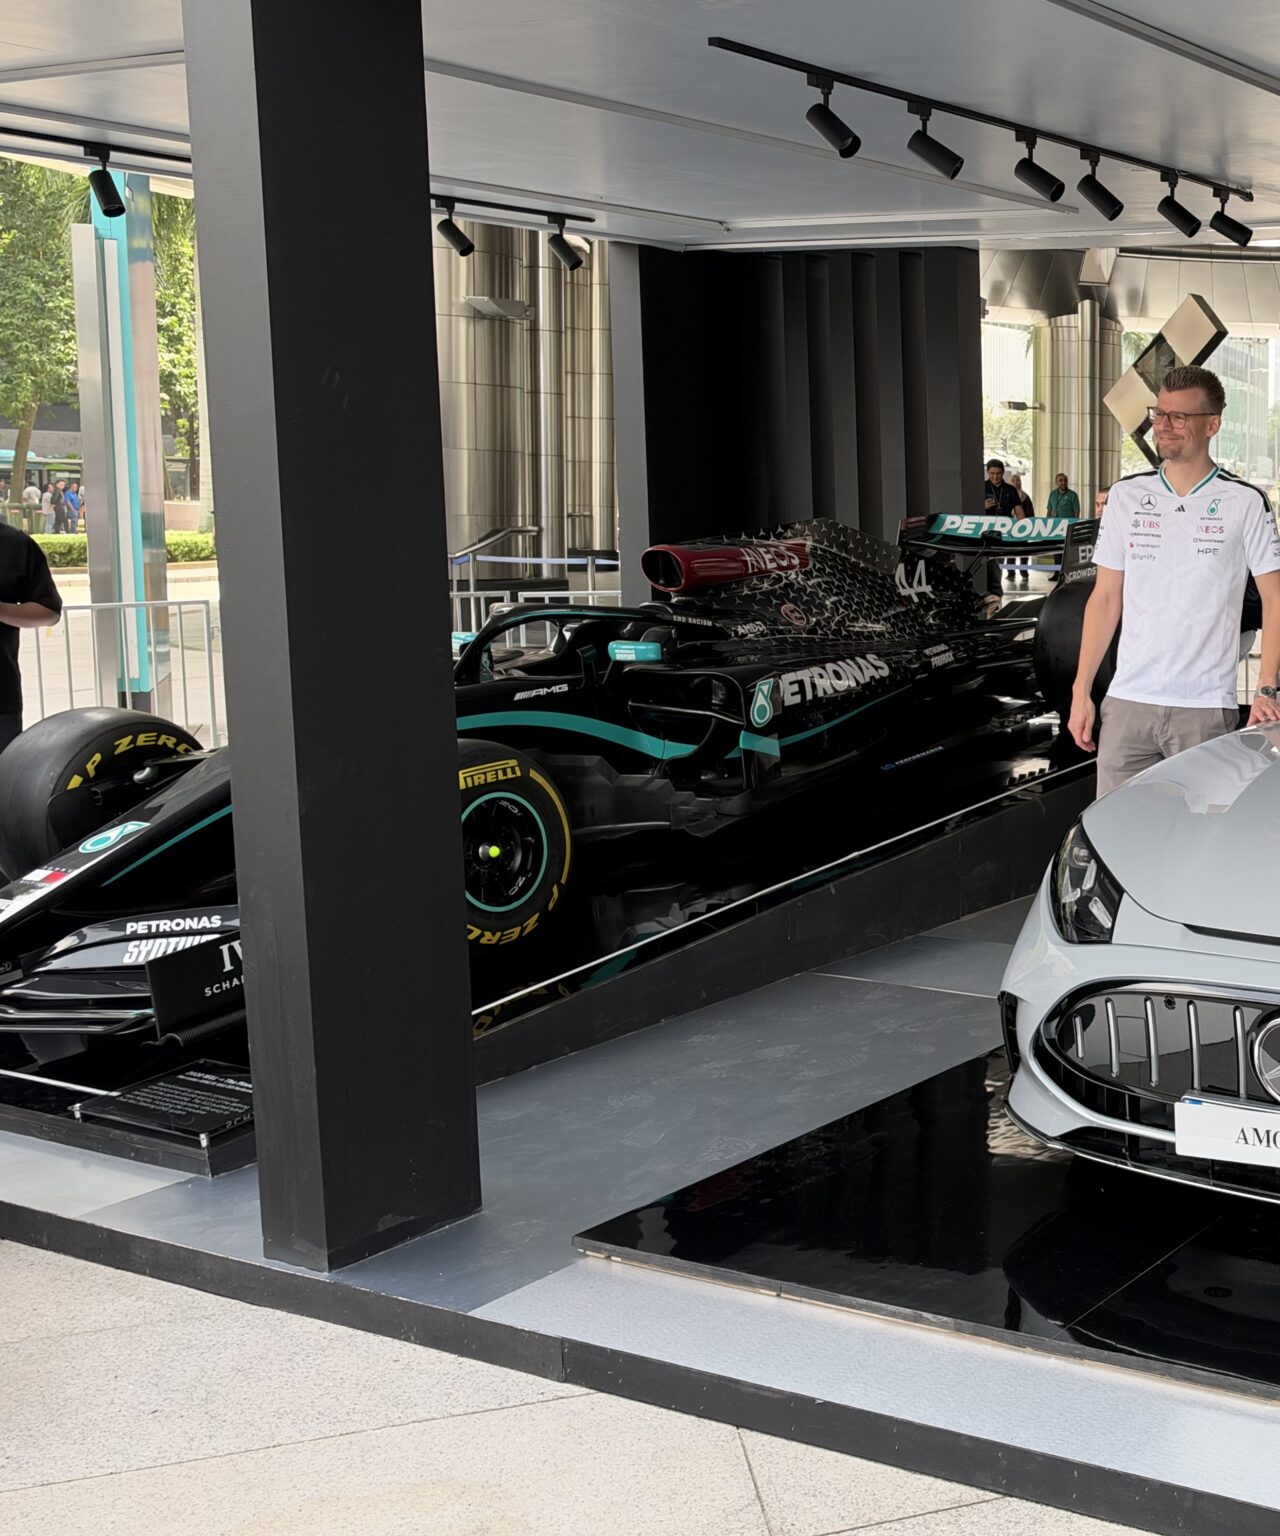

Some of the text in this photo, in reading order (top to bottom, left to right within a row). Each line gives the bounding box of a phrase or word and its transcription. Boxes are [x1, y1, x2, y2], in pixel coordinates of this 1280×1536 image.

[940, 515, 1069, 538] PETRONA
[1142, 520, 1161, 529] UBS
[1196, 525, 1225, 534] INEOS
[739, 545, 800, 574] INEOS
[1197, 547, 1220, 556] HPE
[895, 559, 935, 603] 44
[1067, 566, 1097, 581] CROWDS
[688, 617, 713, 627] RACISM
[778, 653, 890, 707] ETRONAS
[459, 758, 522, 791] PIRELLI
[125, 915, 222, 935] PETRONAS
